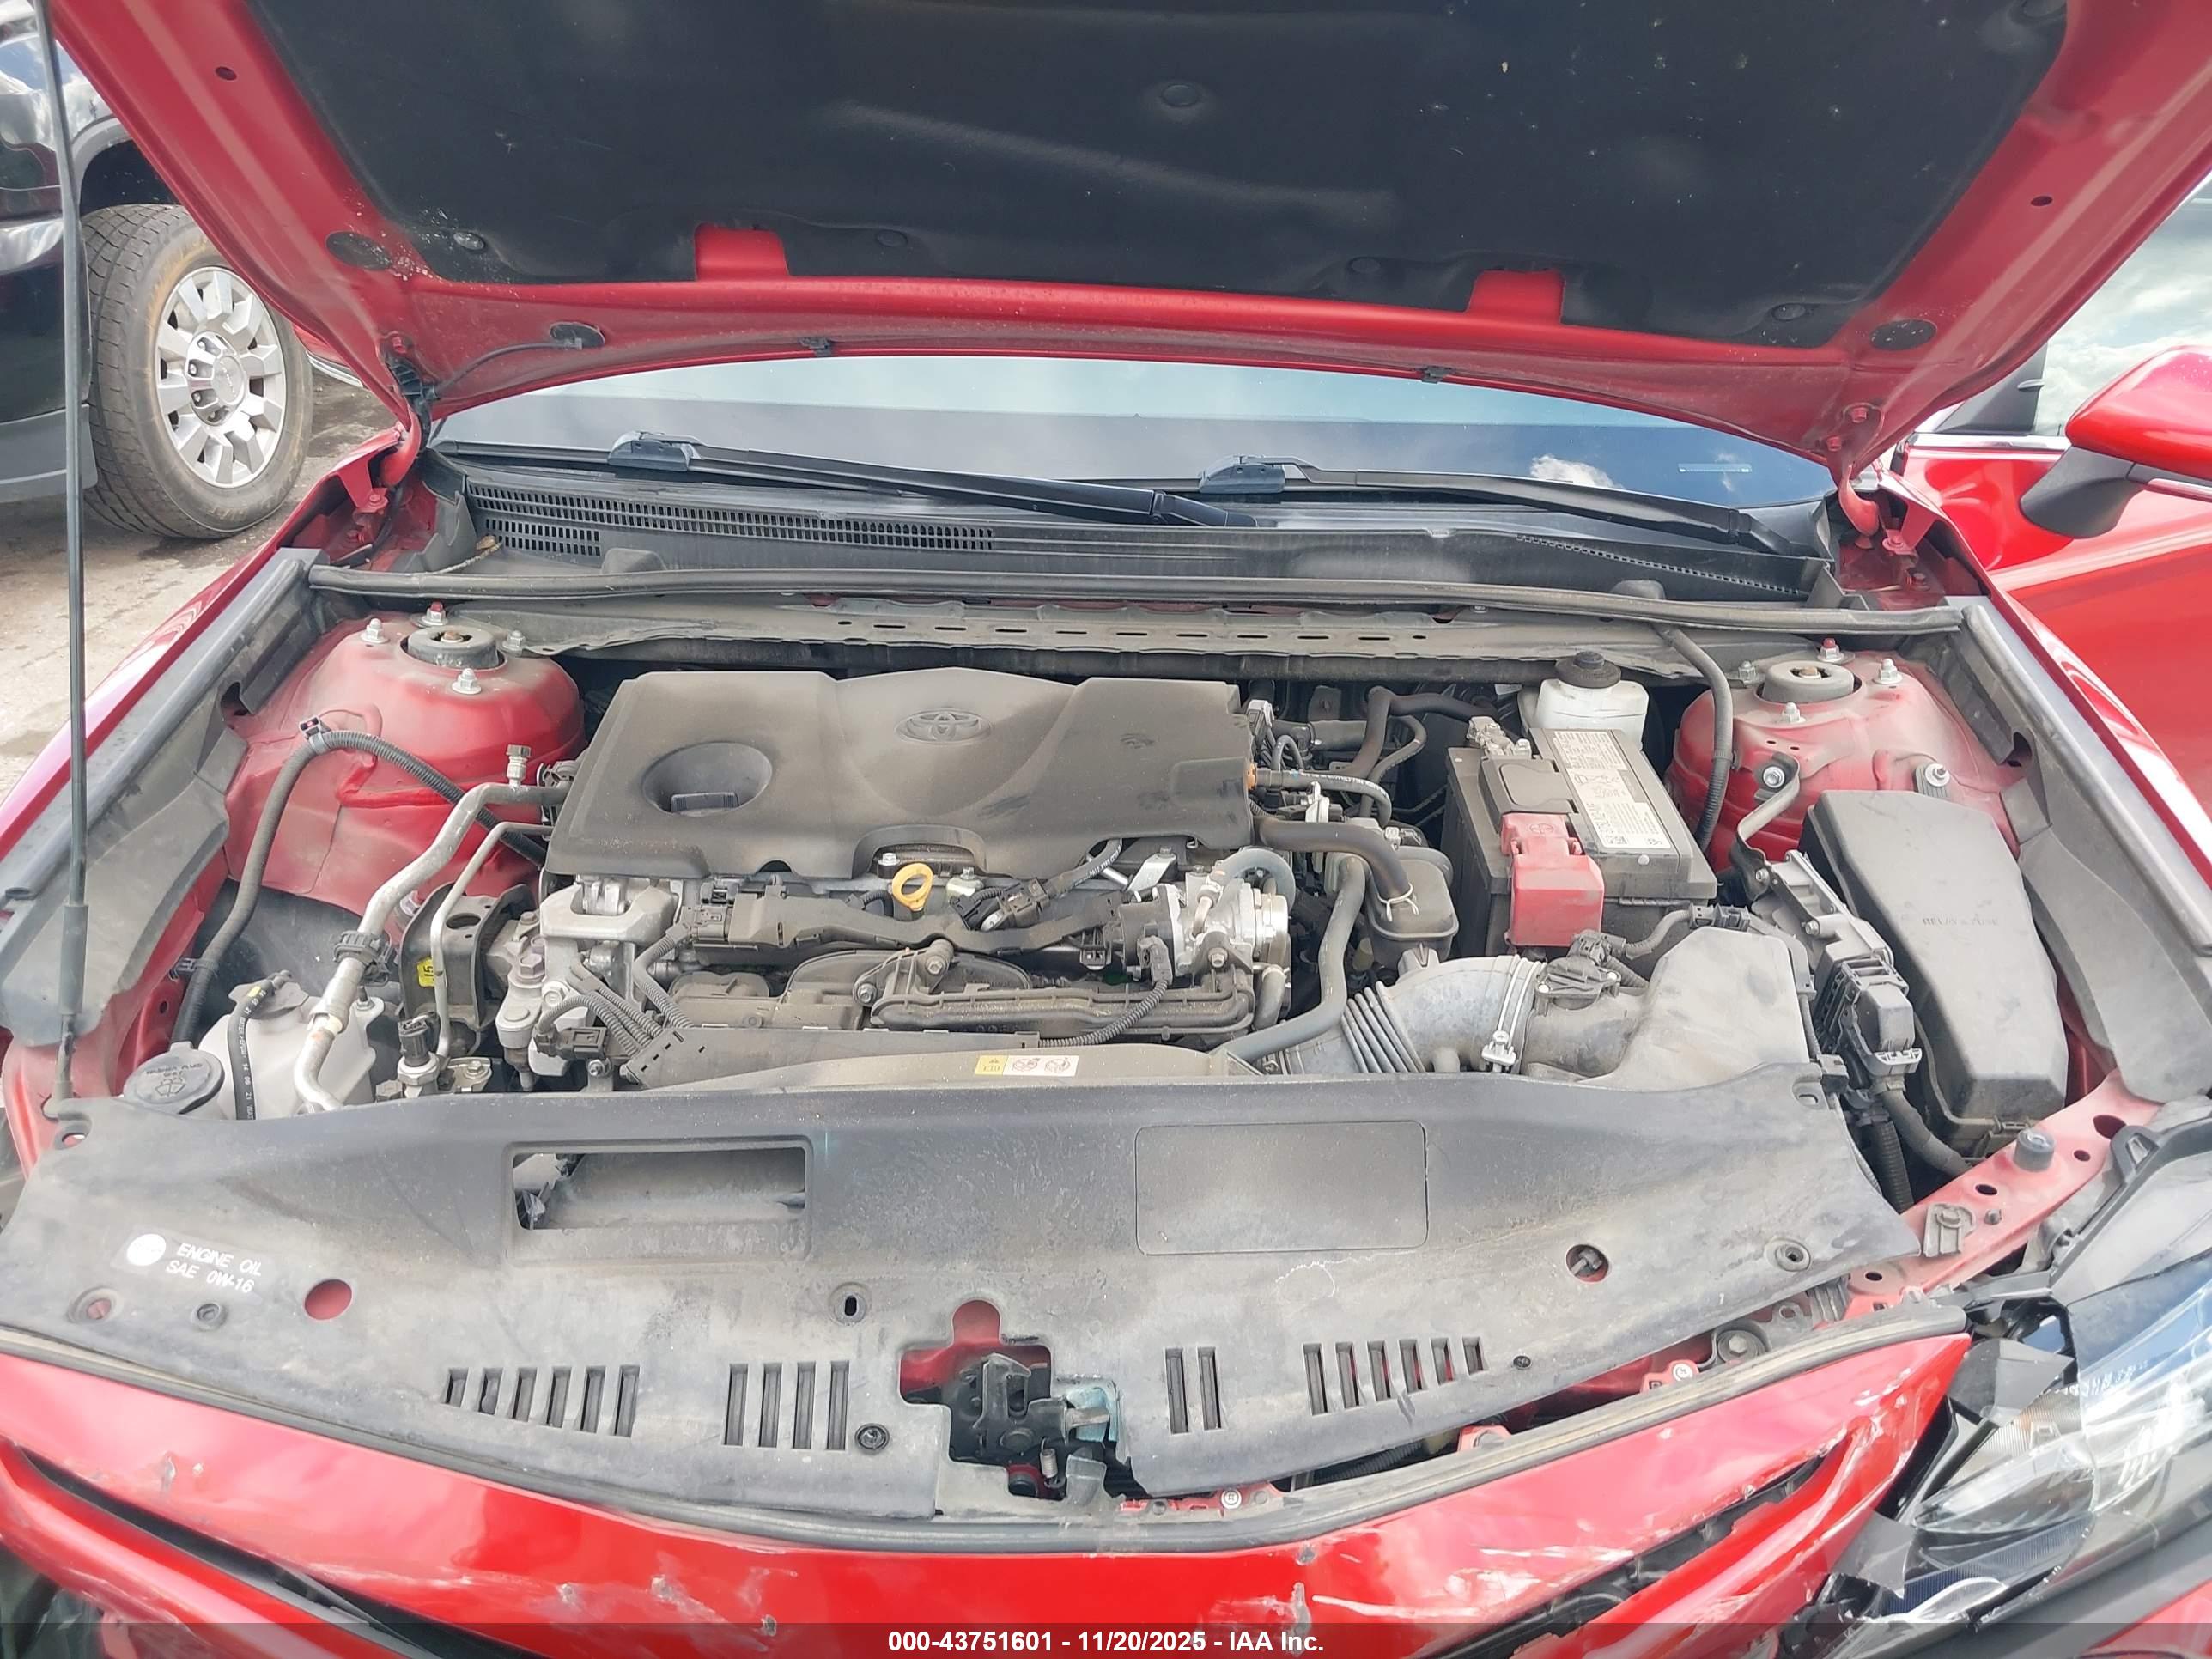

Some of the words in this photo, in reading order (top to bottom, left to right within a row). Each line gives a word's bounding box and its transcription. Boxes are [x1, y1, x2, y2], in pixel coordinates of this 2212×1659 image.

[166, 1259, 200, 1279] SAE
[206, 1270, 255, 1293] 0W-16
[176, 1243, 234, 1267] ENGINE
[240, 1259, 262, 1277] OIL
